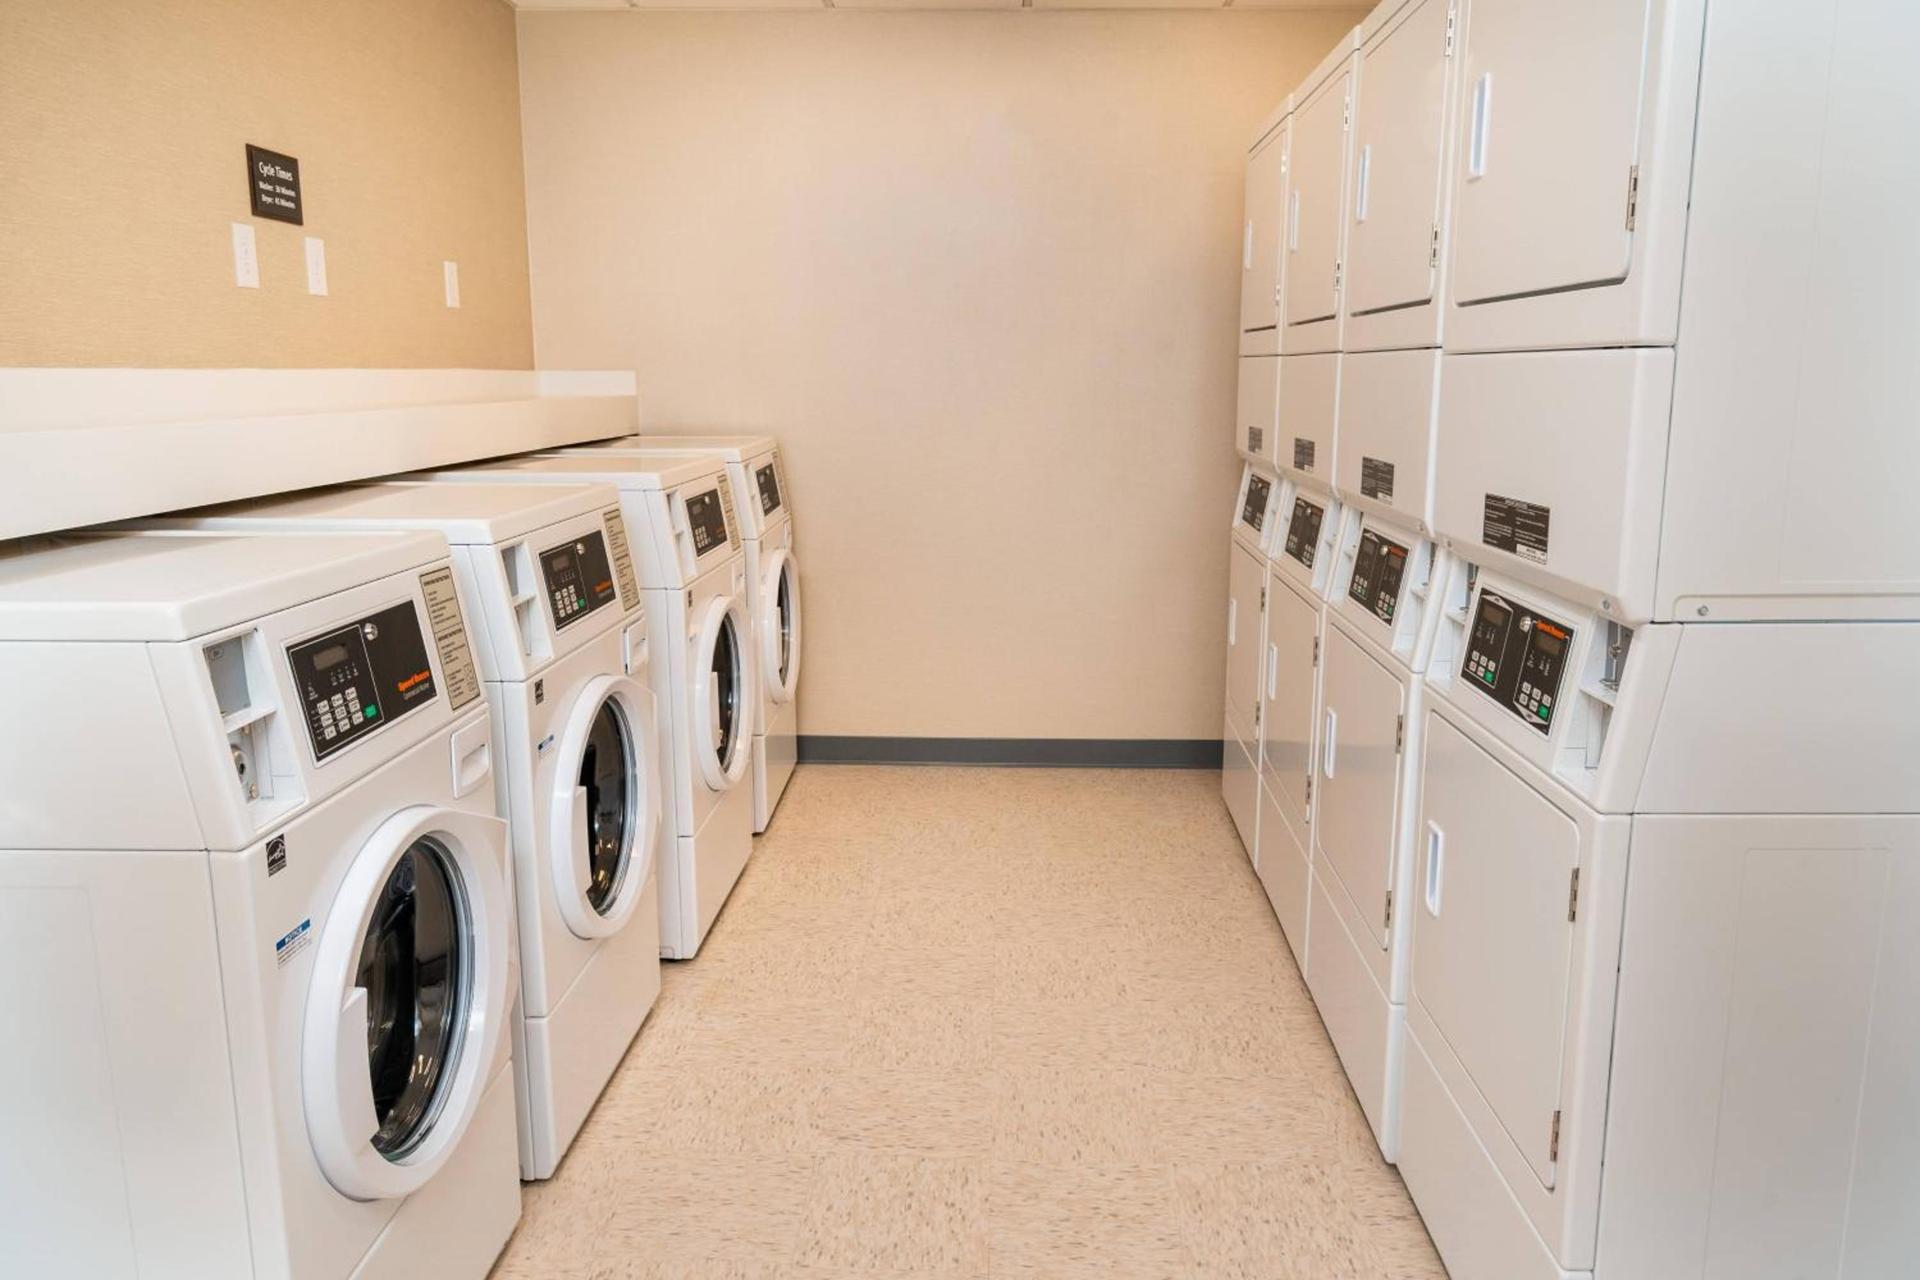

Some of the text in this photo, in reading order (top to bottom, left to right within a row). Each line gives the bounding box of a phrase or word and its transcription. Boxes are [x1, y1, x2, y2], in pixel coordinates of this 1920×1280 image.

[258, 161, 293, 182] Cycle Times
[398, 677, 415, 692] Speed
